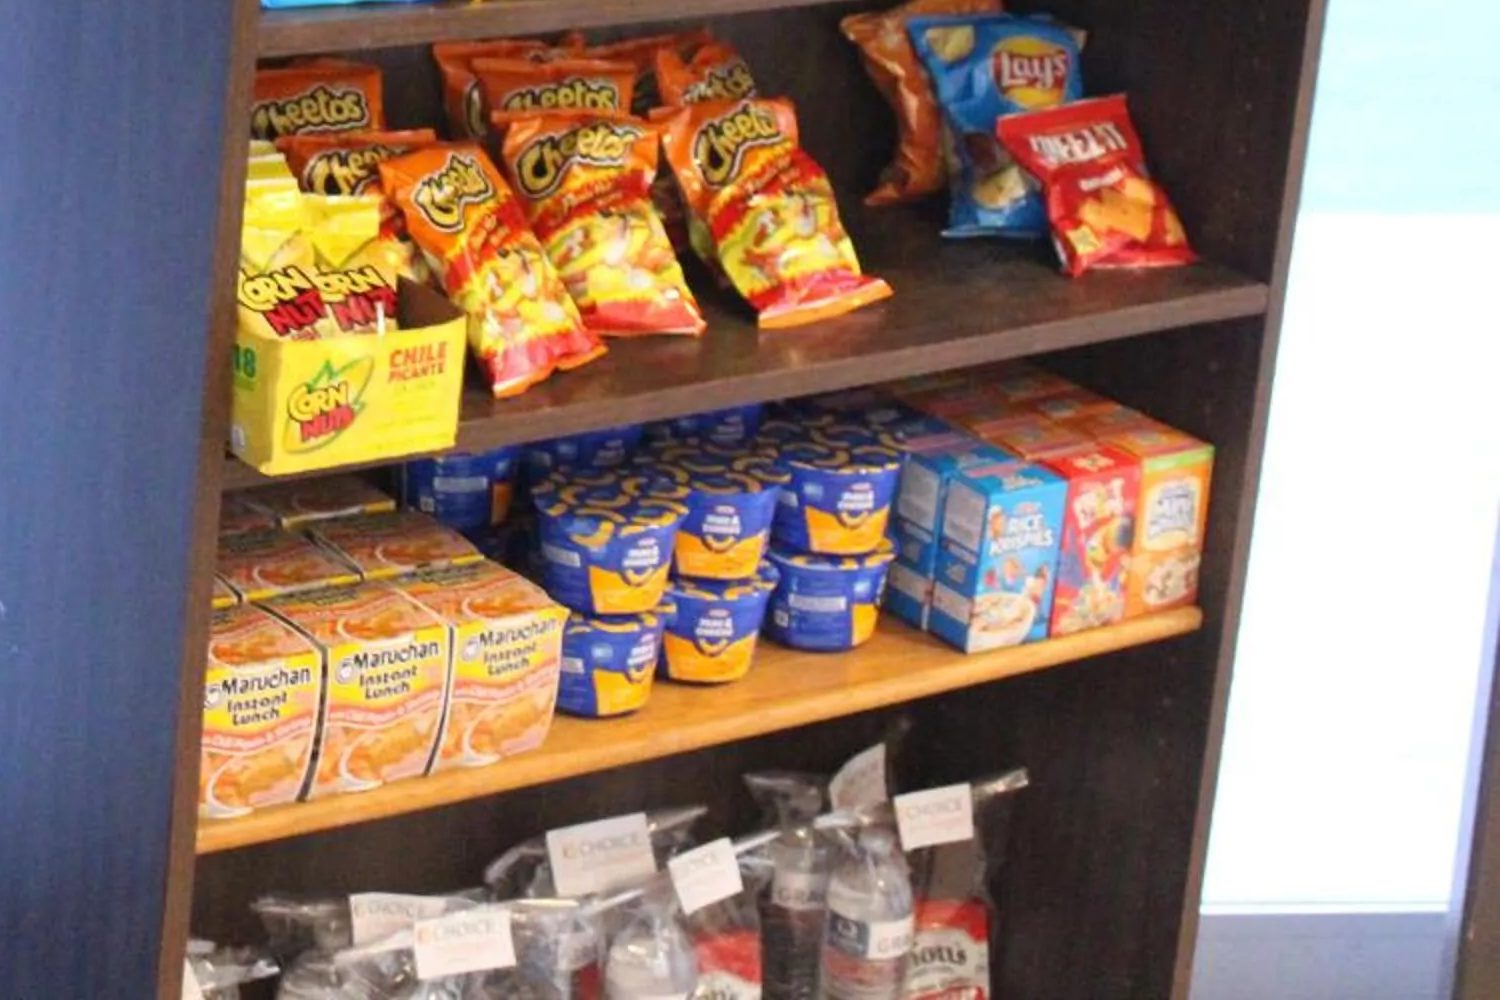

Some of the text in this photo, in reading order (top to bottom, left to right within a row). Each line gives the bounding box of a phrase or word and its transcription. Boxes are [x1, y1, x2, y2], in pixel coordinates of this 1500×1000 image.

[1001, 50, 1071, 87] Lay's
[252, 85, 366, 139] Cheetos
[389, 342, 448, 368] CHILE
[387, 362, 446, 383] PICANTE
[287, 380, 349, 422] CORN
[478, 617, 557, 646] Maruchan
[353, 639, 440, 670] Maruchan
[483, 643, 538, 664] Instant
[359, 665, 418, 688] Instant
[487, 656, 532, 677] Lunch
[222, 665, 312, 695] Maruchan
[364, 680, 412, 701] Lunch
[226, 691, 289, 714] Instant
[232, 707, 282, 727] Lunch
